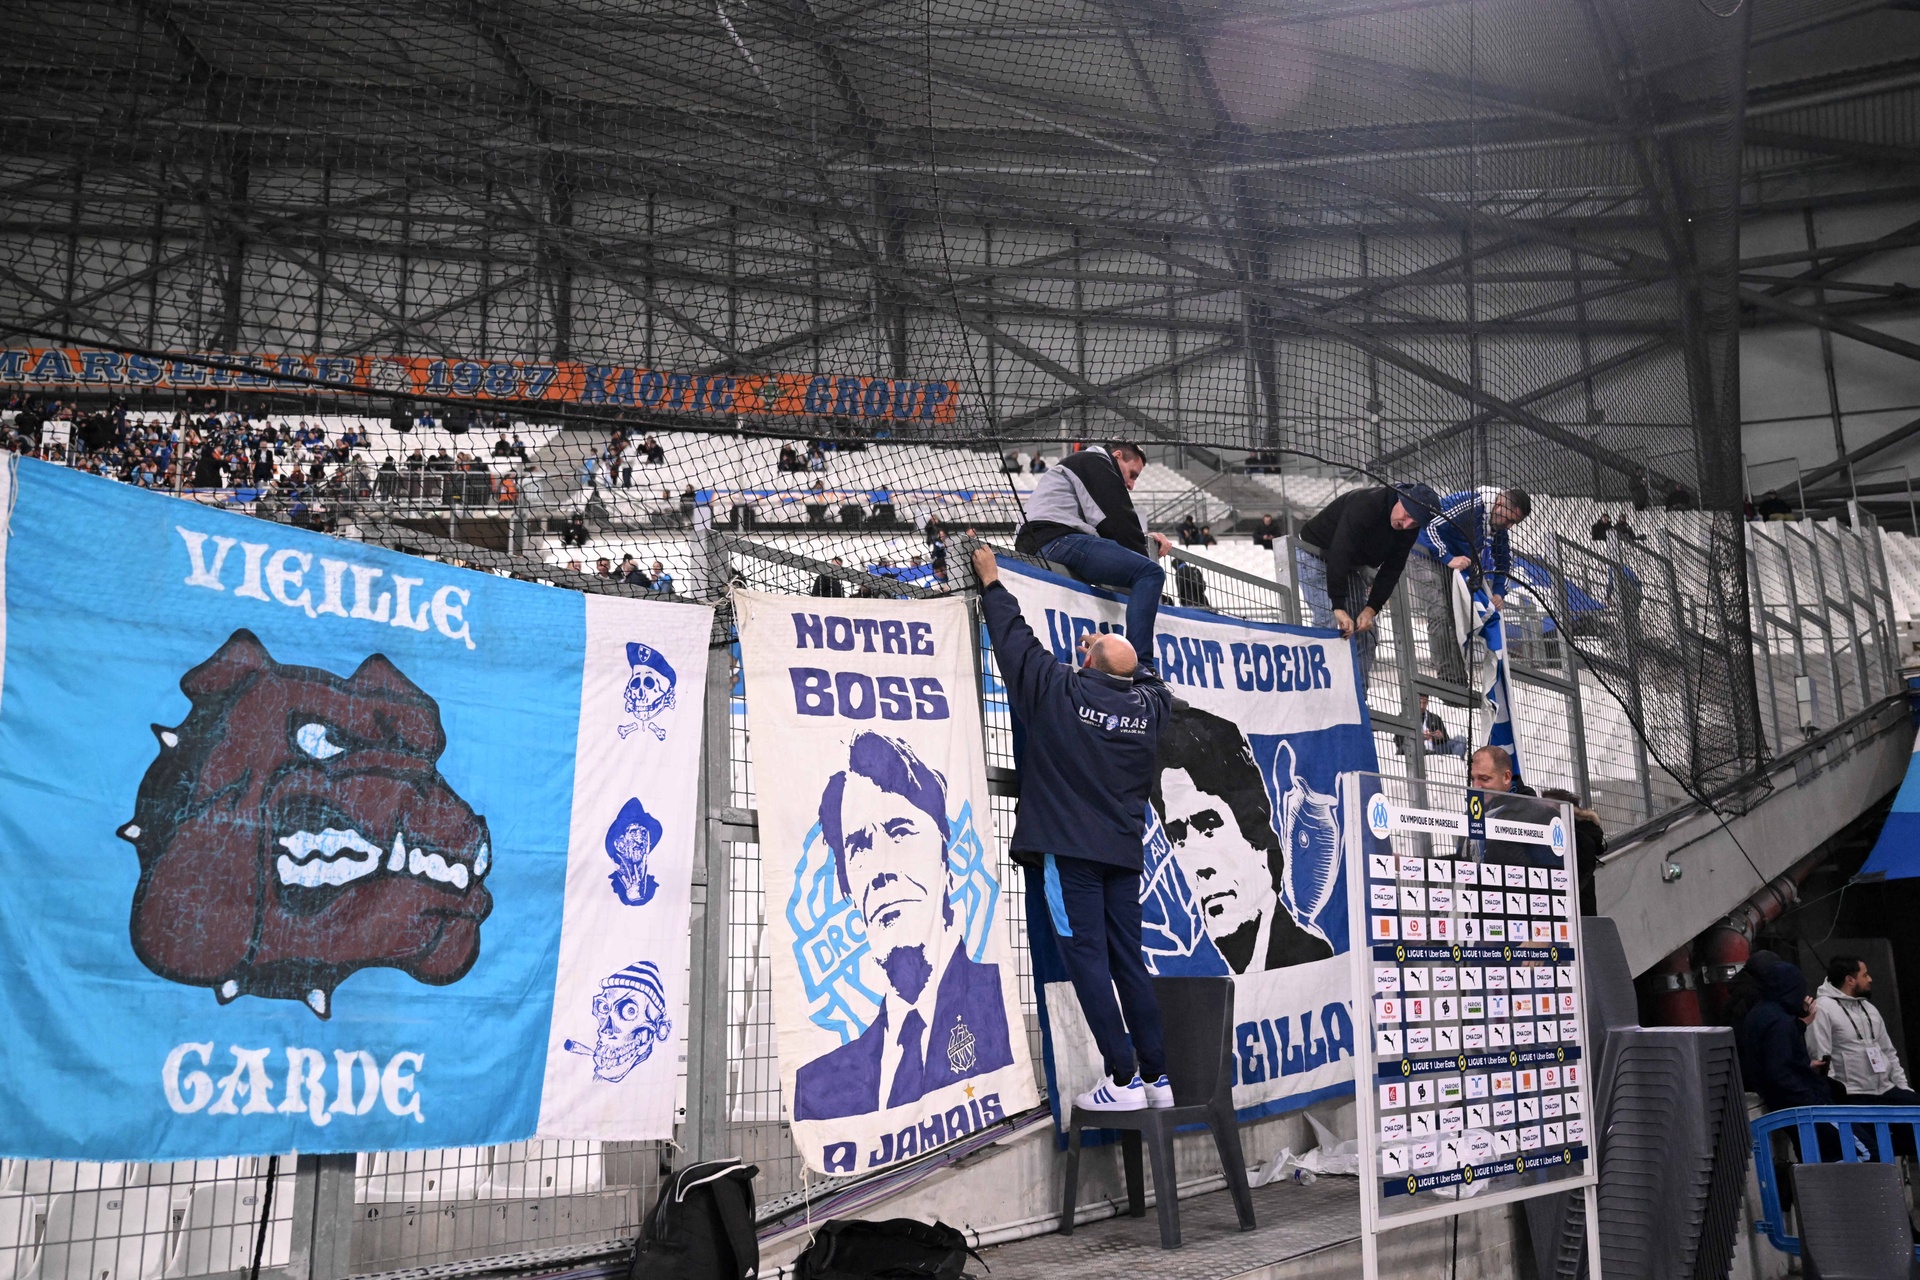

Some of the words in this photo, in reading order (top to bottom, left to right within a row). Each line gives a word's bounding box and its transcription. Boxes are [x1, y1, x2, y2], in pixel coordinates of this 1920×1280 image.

[426, 360, 557, 398] 1987
[579, 365, 736, 412] KAOTIC
[804, 375, 951, 420] GROUP
[175, 525, 477, 650] VIEILLE
[791, 613, 934, 656] NOTRE
[1045, 608, 1224, 689] VAANT
[1230, 642, 1331, 692] COEUR
[788, 667, 950, 721] BOSS
[1400, 814, 1427, 826] OLYMPIQUE
[1428, 818, 1434, 826] DE
[1435, 819, 1458, 828] MARSEILLE
[1494, 826, 1517, 835] OLYMPIQUE
[1524, 829, 1544, 838] MARSEILLE
[1407, 949, 1424, 958] LIGUE
[1439, 950, 1450, 958] Eats
[1462, 950, 1478, 958] LIGUE
[1468, 1057, 1484, 1066] LIGUE
[1518, 1053, 1533, 1062] LIGUE
[1412, 1062, 1429, 1071] LIGUE
[1434, 1061, 1445, 1069] Uber
[1444, 1060, 1456, 1068] Eats
[162, 1040, 425, 1127] GARDE
[823, 1141, 857, 1173] A
[868, 1092, 1007, 1168] JAMAIS
[1474, 1168, 1490, 1177] LIGUE
[1493, 1165, 1504, 1174] Uber
[1504, 1163, 1514, 1171] Eats
[1525, 1158, 1540, 1168] LIGUE
[1418, 1178, 1436, 1188] LIGUE
[1440, 1175, 1450, 1184] Uber
[1450, 1172, 1462, 1181] Eats
